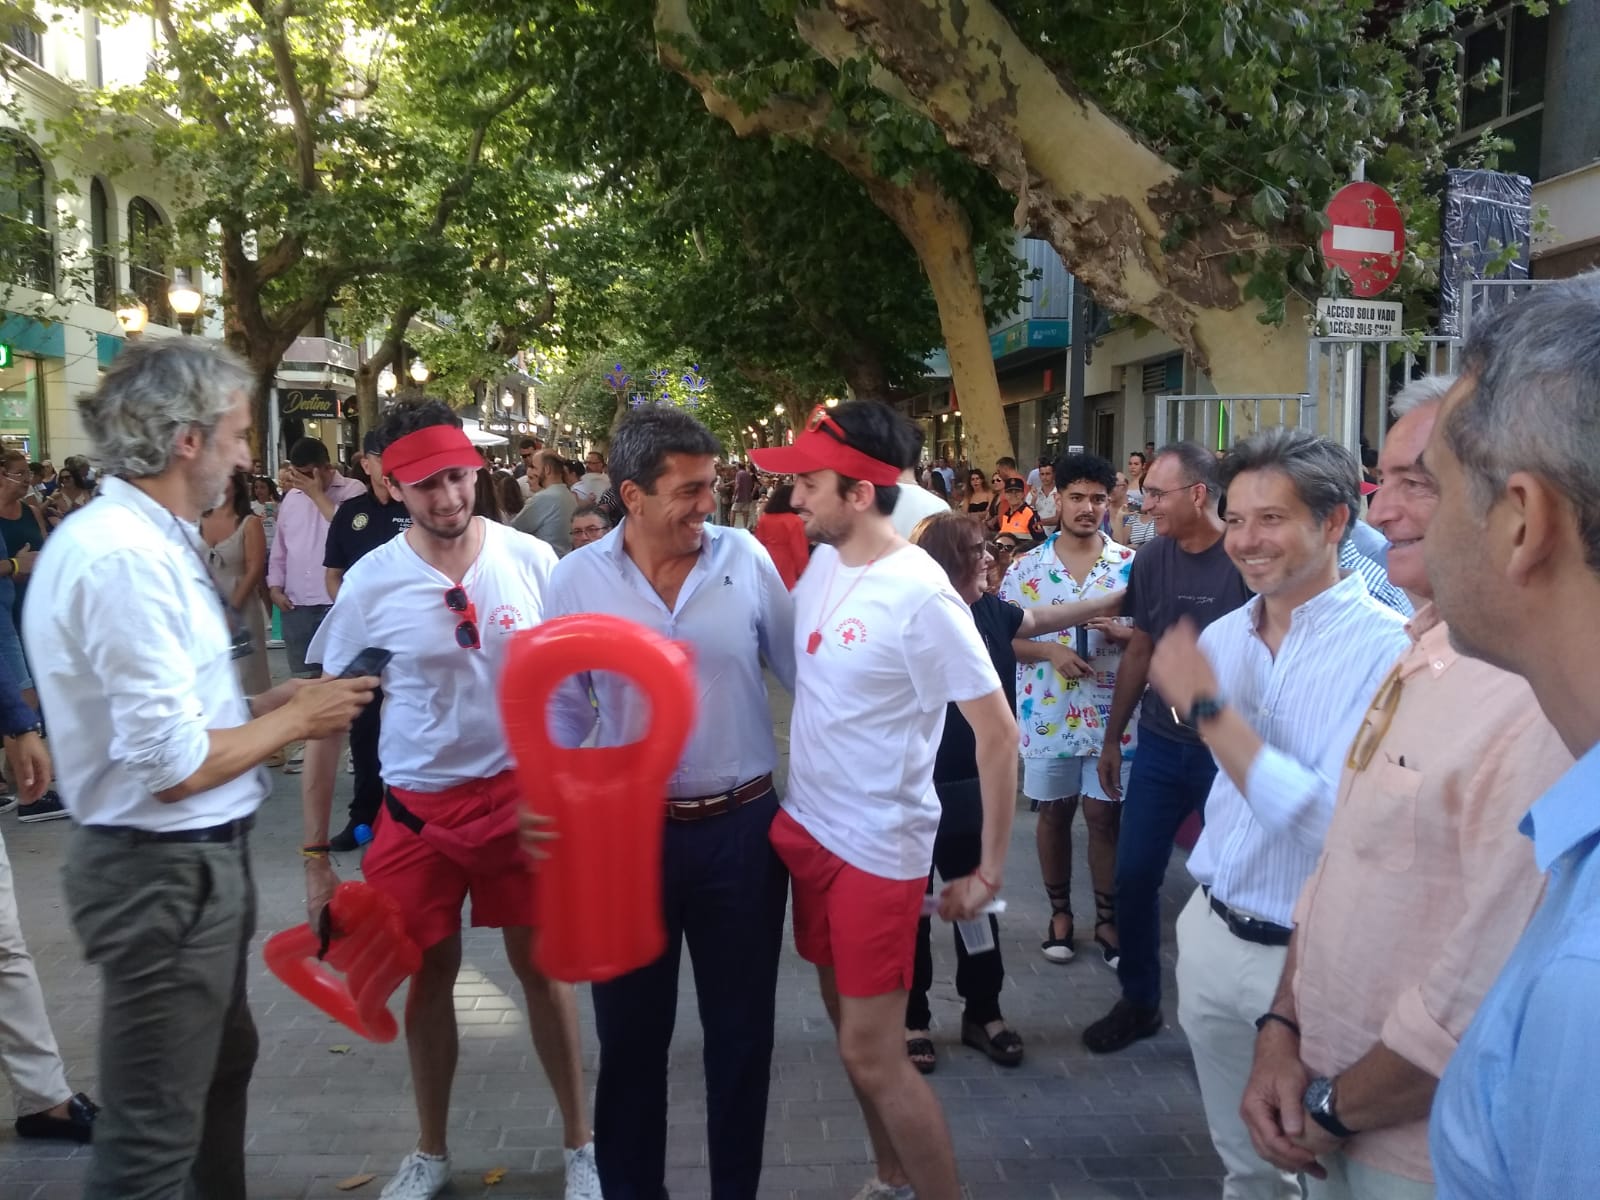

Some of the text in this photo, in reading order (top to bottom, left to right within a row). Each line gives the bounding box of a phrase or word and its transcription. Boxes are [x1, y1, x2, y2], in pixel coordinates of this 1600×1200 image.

[1326, 305, 1396, 322] ACCESO SOLO VADO
[282, 391, 331, 414] Destino
